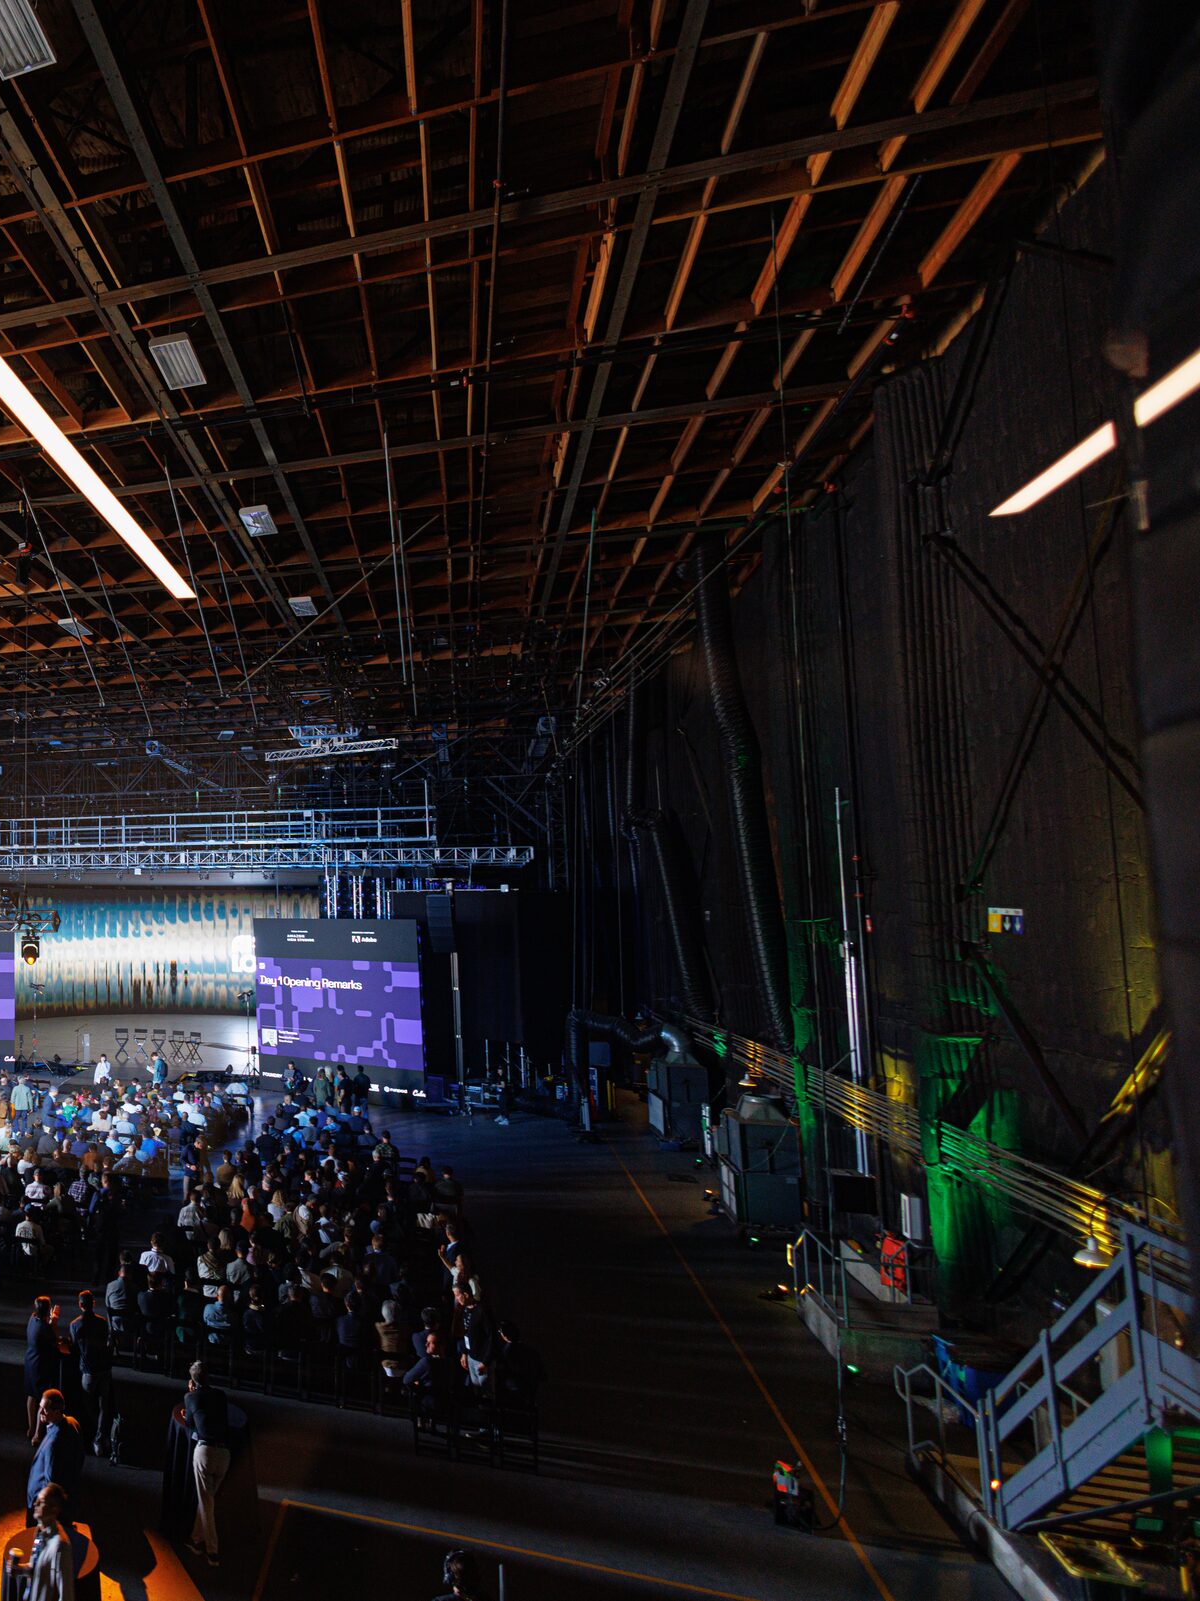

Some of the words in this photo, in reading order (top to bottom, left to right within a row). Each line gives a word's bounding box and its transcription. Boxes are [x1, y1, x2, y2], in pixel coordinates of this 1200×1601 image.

[259, 975, 278, 988] Day
[277, 976, 283, 986] 1
[283, 976, 322, 990] Opening
[322, 978, 363, 990] Remarks
